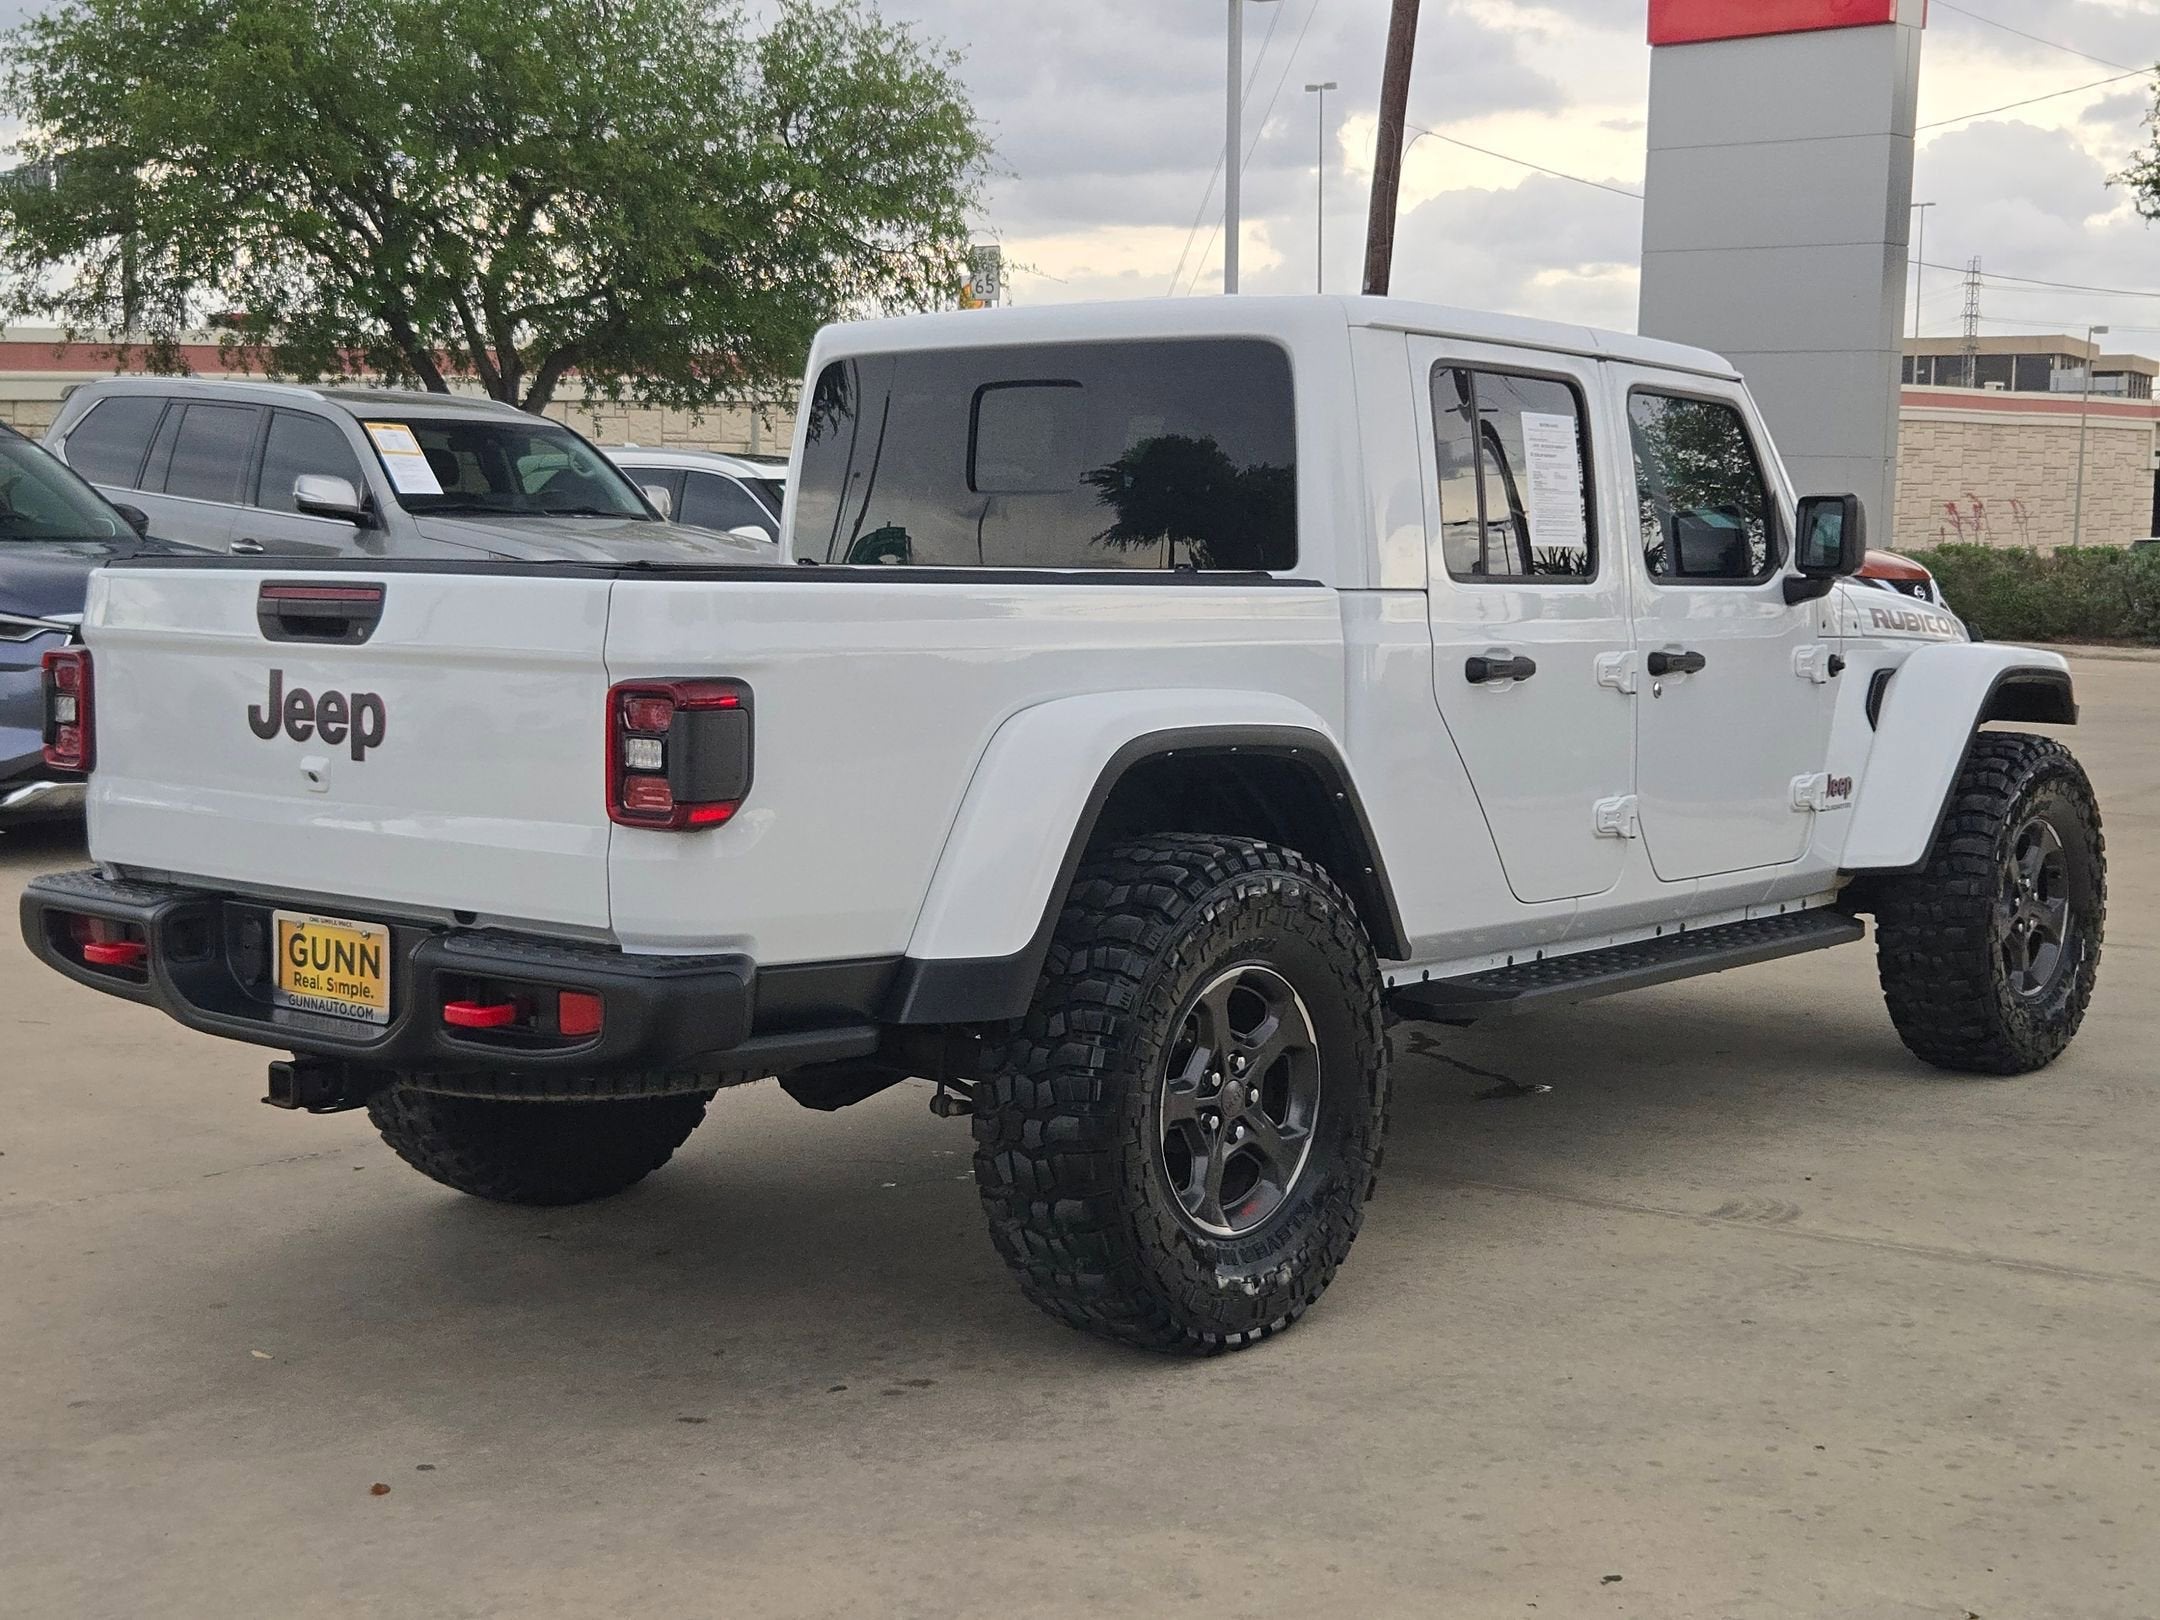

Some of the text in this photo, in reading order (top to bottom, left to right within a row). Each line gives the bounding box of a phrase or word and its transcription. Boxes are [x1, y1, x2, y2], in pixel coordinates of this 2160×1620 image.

[975, 279, 994, 294] 65
[248, 668, 386, 762] Jeep
[1825, 774, 1852, 800] Jeep
[289, 932, 380, 979] GUNN
[294, 971, 375, 999] Real. Simple.
[288, 993, 374, 1020] GUNNAUTO.COM
